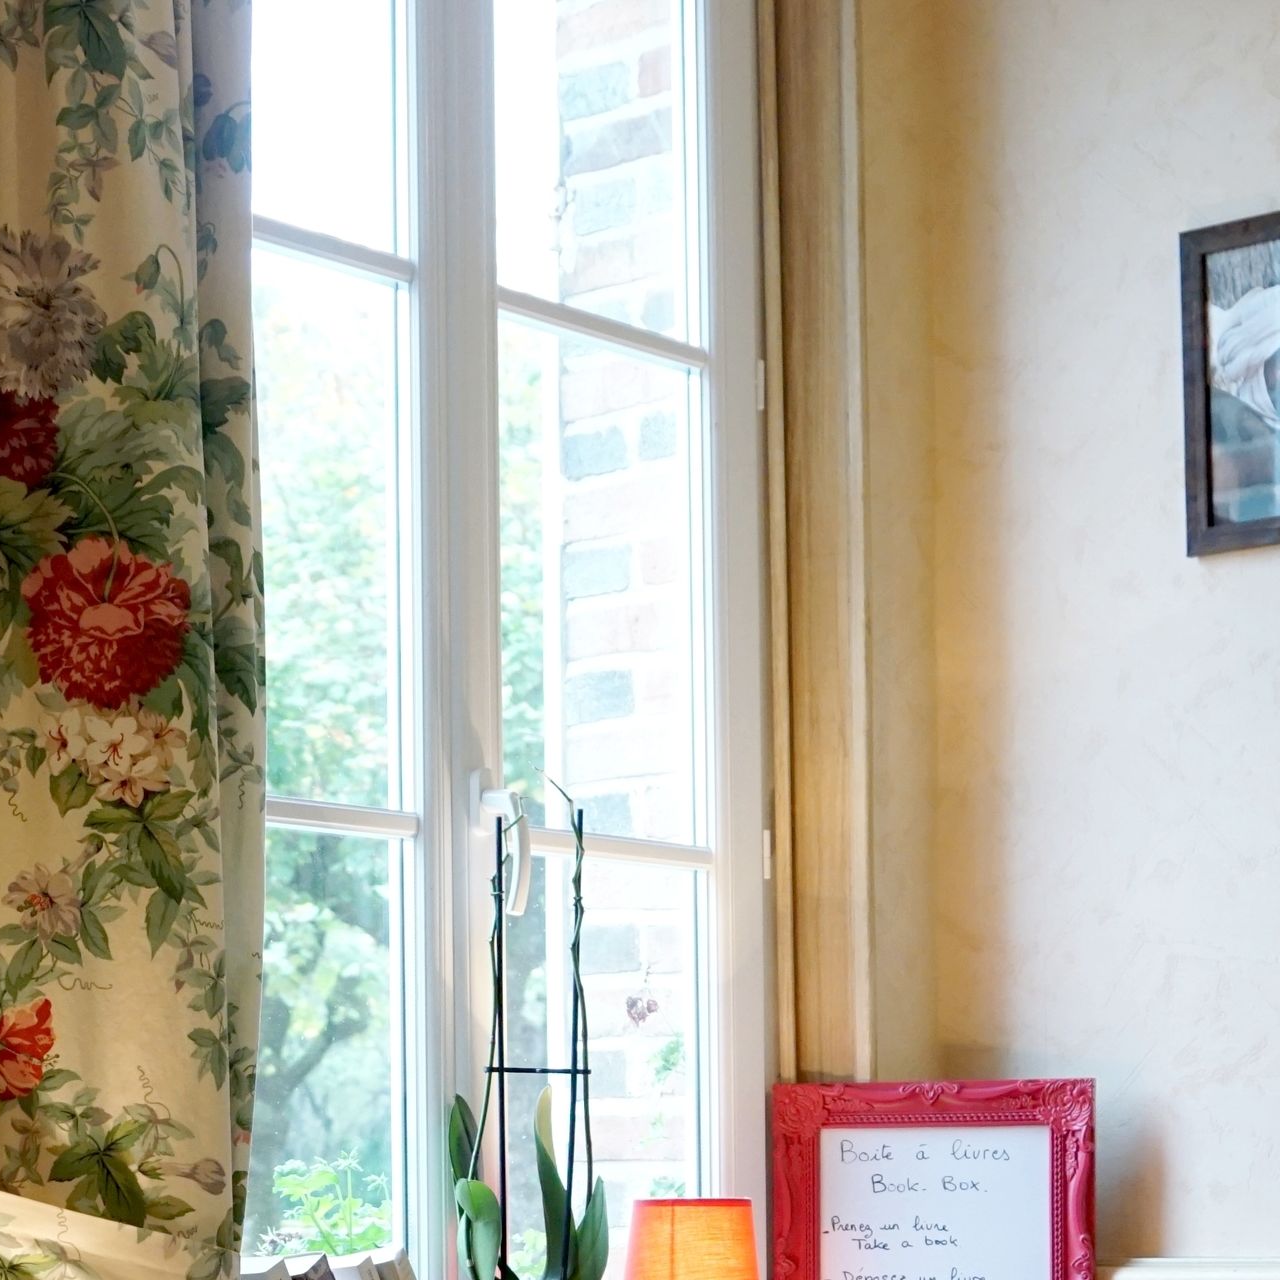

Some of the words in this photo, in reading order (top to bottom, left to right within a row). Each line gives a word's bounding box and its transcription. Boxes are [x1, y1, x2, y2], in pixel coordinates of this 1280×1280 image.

[951, 1138, 1011, 1162] livres
[879, 1222, 900, 1231] un
[913, 1215, 949, 1232] livre
[851, 1238, 891, 1251] Take
[901, 1239, 913, 1248] a
[924, 1235, 959, 1247] book
